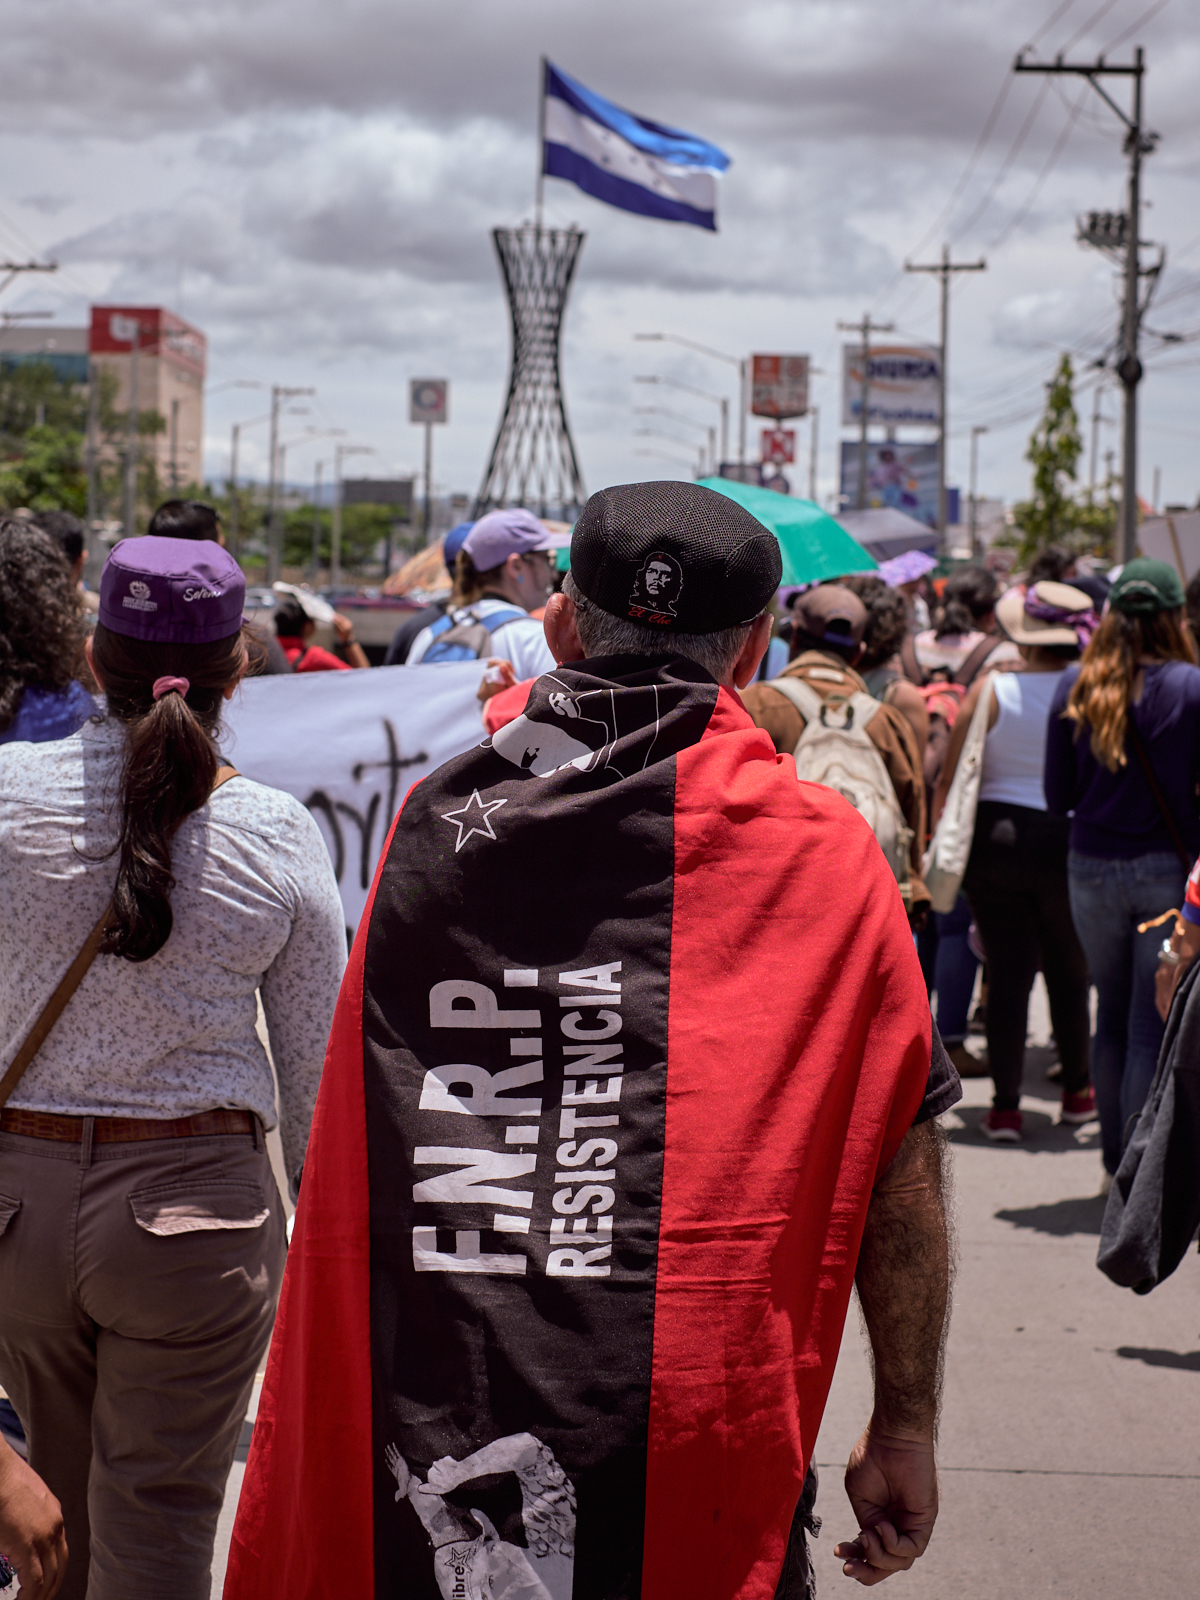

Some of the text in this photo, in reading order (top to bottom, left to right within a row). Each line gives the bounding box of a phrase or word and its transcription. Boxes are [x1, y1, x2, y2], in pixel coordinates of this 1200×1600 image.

[628, 607, 671, 624] El Che
[545, 960, 624, 1276] RESISTENCIA
